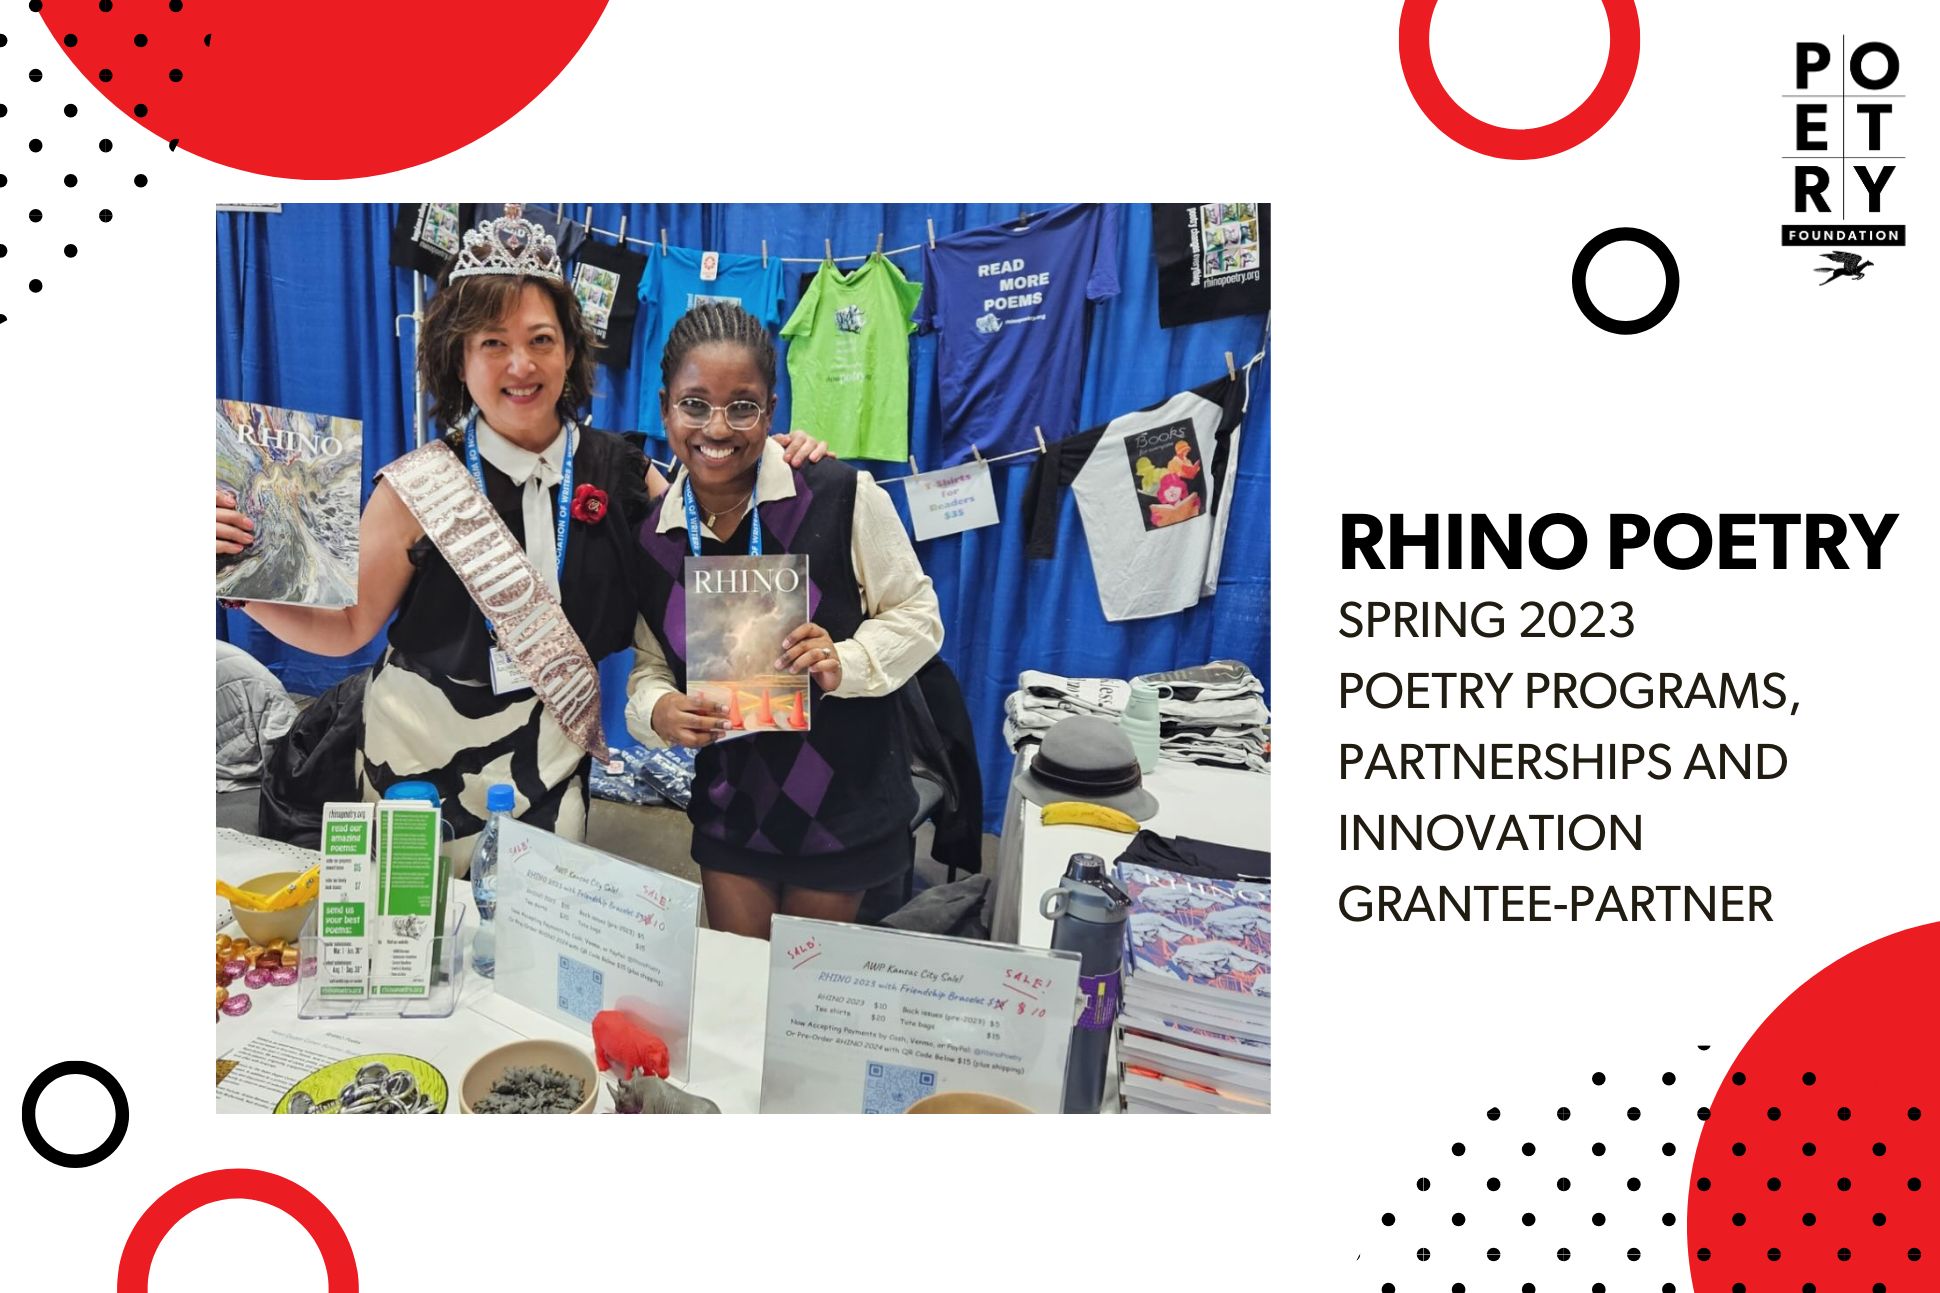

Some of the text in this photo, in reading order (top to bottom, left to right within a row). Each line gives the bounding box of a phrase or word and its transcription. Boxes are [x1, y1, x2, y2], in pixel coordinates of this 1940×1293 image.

[978, 258, 1025, 277] READ
[1000, 272, 1050, 291] MORE
[1203, 269, 1260, 288] rhinopoetry.org
[984, 291, 1043, 312] POEMS
[237, 423, 343, 458] RHINO
[561, 469, 573, 503] WRITERS
[559, 505, 567, 517] OF
[693, 567, 799, 593] RHINO
[863, 961, 964, 984] AWP Kansas City Sale!
[818, 971, 851, 984] RHINO
[878, 982, 898, 991] with
[899, 984, 946, 1000] Friendship
[947, 991, 984, 1005] Bracelet
[808, 1020, 842, 1033] Accepting
[844, 1026, 876, 1038] Payments
